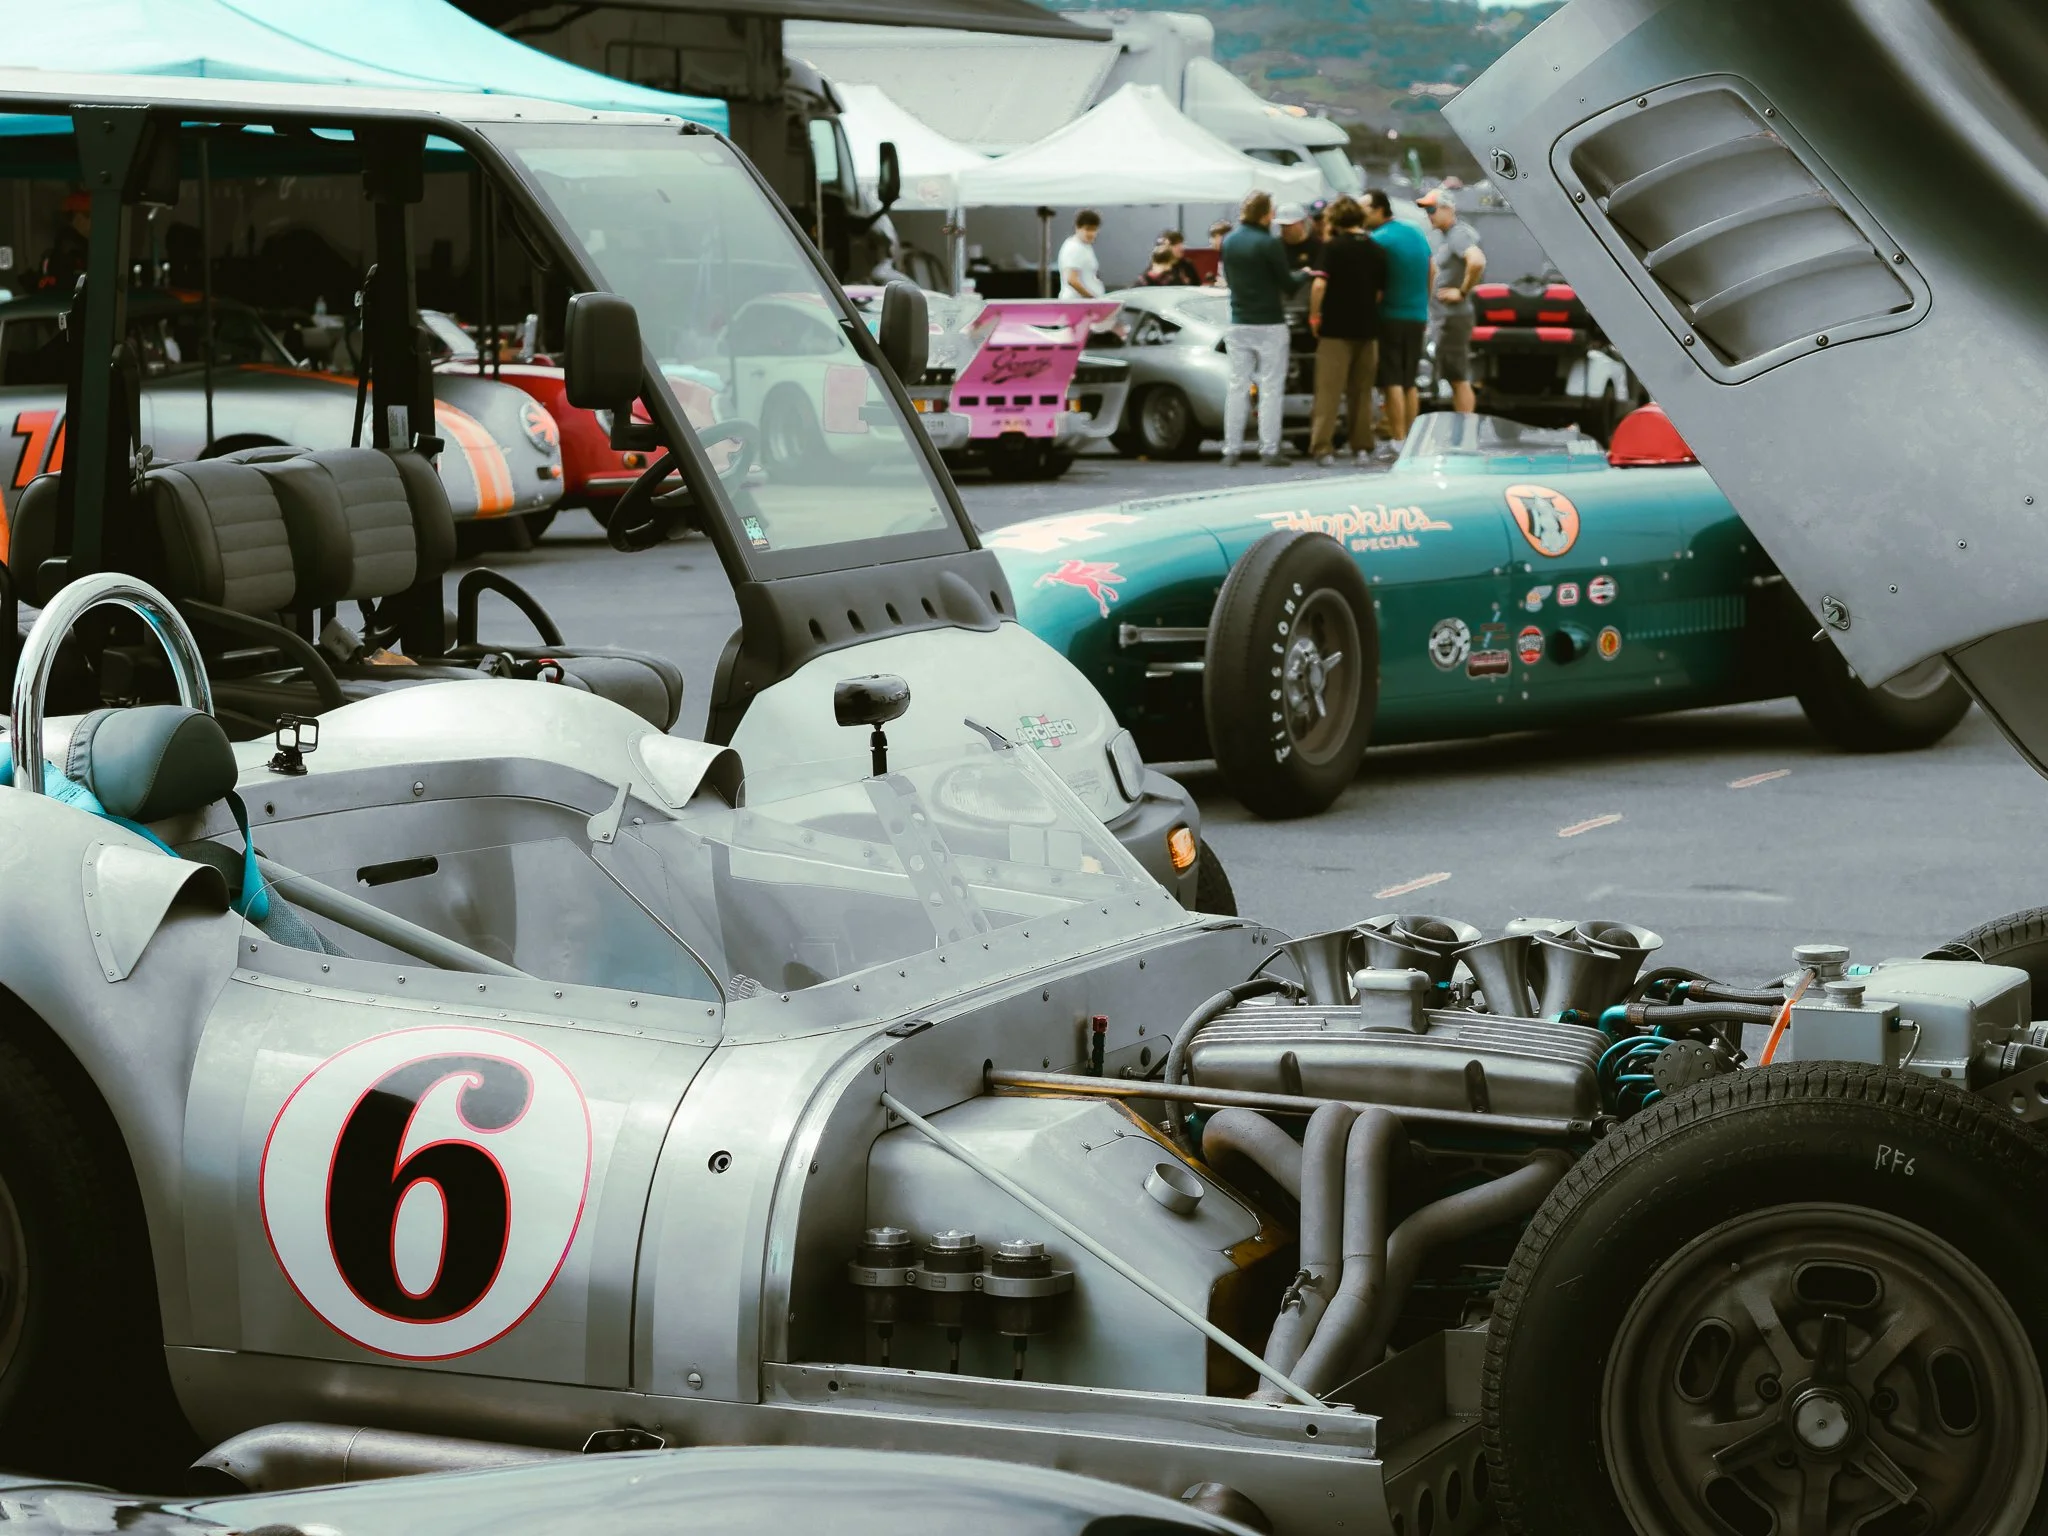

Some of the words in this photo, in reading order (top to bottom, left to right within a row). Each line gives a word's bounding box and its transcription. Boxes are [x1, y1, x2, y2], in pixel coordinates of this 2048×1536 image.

[1254, 504, 1452, 546] Hopkins
[1351, 534, 1420, 552] SPECIAL
[1015, 719, 1078, 743] ARCIERO
[1874, 1144, 1916, 1176] RF6
[325, 1051, 535, 1325] 6
